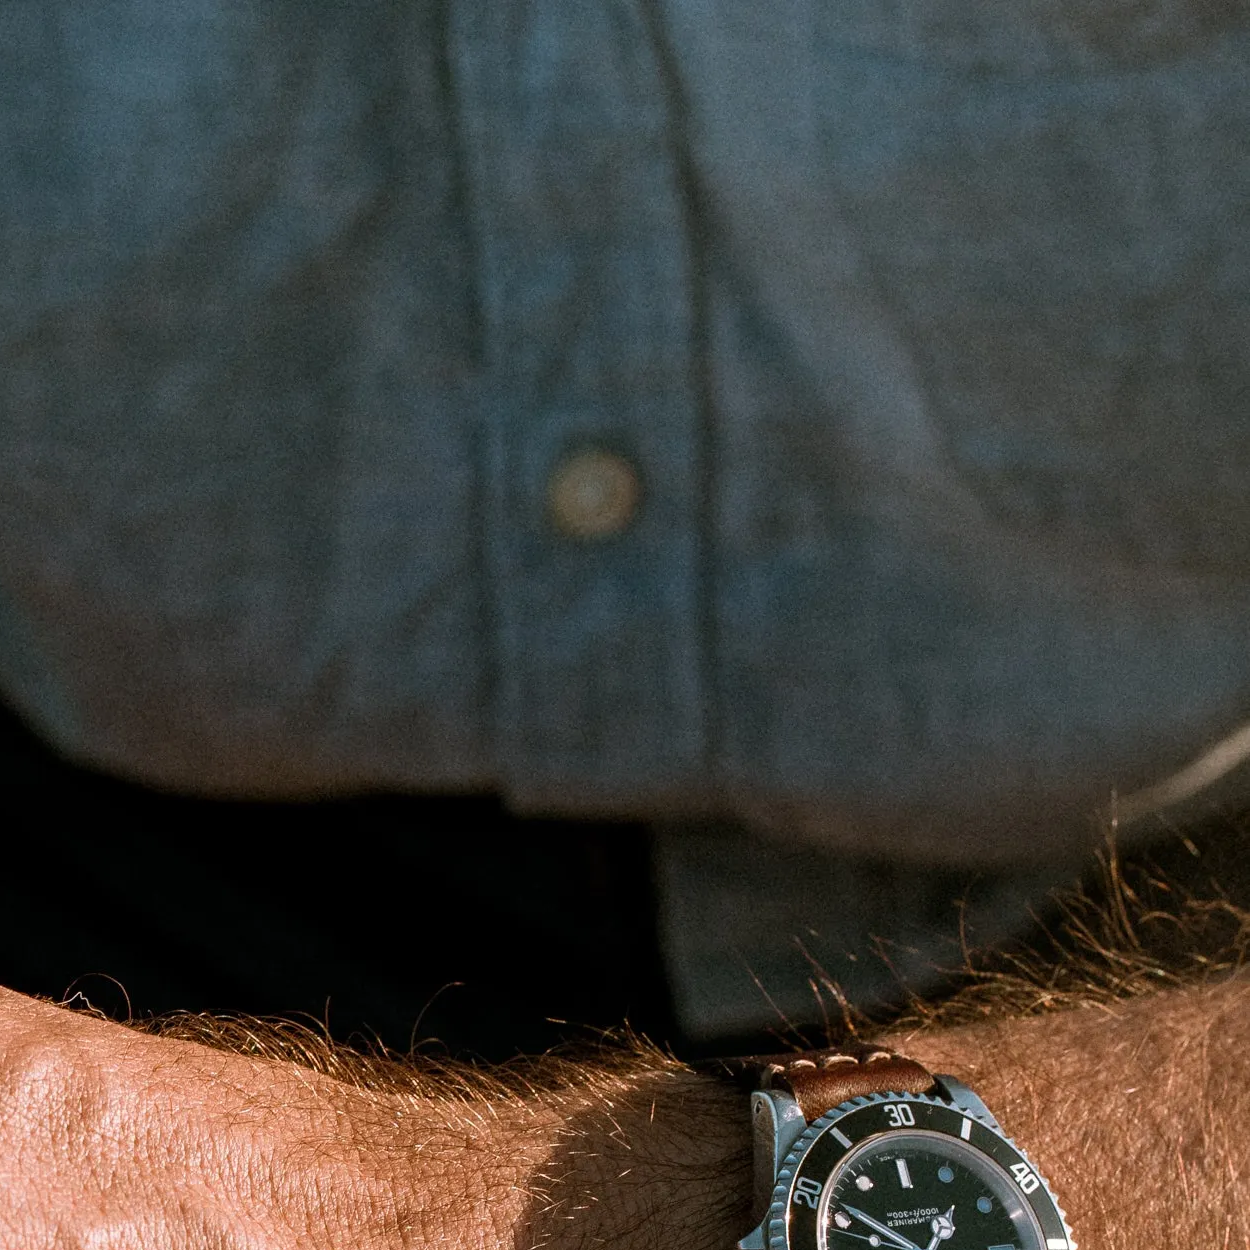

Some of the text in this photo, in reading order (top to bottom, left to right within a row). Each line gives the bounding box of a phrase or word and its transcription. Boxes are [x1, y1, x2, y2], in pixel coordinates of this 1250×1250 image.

[884, 1104, 915, 1127] 30
[793, 1177, 823, 1209] 20
[1009, 1162, 1039, 1195] 40
